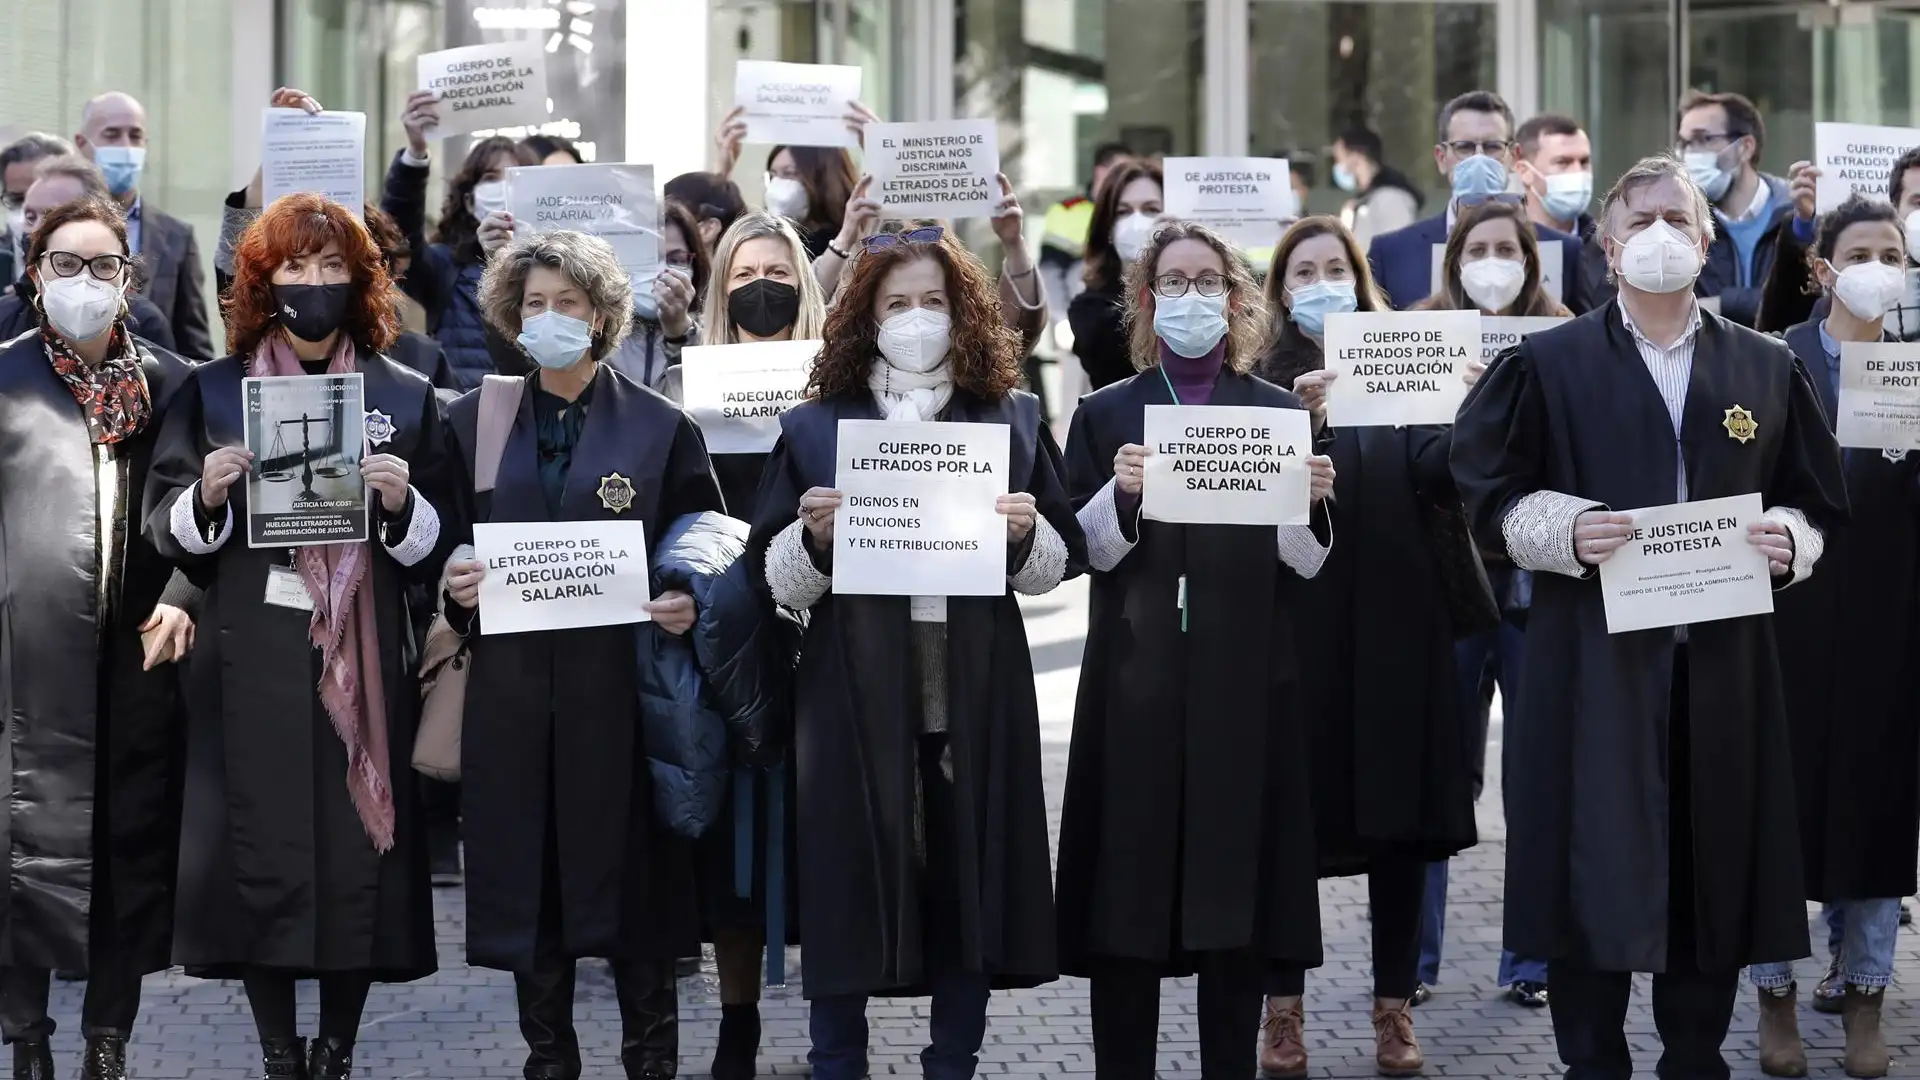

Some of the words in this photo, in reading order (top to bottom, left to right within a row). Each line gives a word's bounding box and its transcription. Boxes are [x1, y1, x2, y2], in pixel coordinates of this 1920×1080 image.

[447, 59, 494, 72] CUERPO
[497, 57, 512, 67] DE
[429, 73, 488, 88] LETRADOS
[492, 69, 516, 80] POR
[518, 67, 534, 76] LA
[442, 81, 524, 100] ADECUACIÓN
[452, 96, 515, 112] SALARIAL
[882, 139, 896, 148] EL
[902, 135, 966, 148] MINISTERIO
[970, 134, 983, 144] DE
[896, 149, 945, 160] JUSTICIA
[948, 148, 972, 157] NOS
[1846, 144, 1894, 155] CUERPO
[902, 161, 967, 172] DISCRIMINA
[1827, 156, 1888, 167] LETRADOS
[1185, 172, 1200, 181] DE
[1203, 172, 1253, 181] JUSTICIA
[1256, 172, 1270, 181] EN
[1839, 170, 1891, 180] ADECUA
[883, 178, 948, 191] LETRADOS
[952, 178, 968, 188] DE
[972, 177, 987, 187] LA
[1199, 184, 1258, 194] PROTESTA
[883, 190, 988, 204] ADMINISTRACIÓN
[536, 210, 595, 221] SALARIAL
[1363, 332, 1420, 344] CUERPO
[1425, 331, 1442, 342] DE
[1482, 333, 1516, 344] ERPO
[1339, 347, 1412, 360] LETRADOS
[1417, 347, 1444, 358] POR
[1450, 346, 1466, 357] LA
[1353, 360, 1452, 376] ADECUACIÓN
[1867, 361, 1885, 371] DE
[1366, 380, 1440, 393] SALARIAL
[723, 406, 786, 418] SALARIA
[1185, 427, 1246, 439] CUERPO
[1251, 428, 1270, 439] DE
[878, 442, 942, 455] CUERPO
[946, 444, 966, 456] DE
[1159, 443, 1237, 455] LETRADOS
[1242, 444, 1272, 456] POR
[1277, 445, 1296, 456] LA
[852, 459, 932, 472] LETRADOS
[937, 461, 968, 473] POR
[973, 462, 992, 473] LA
[1173, 458, 1281, 474] ADECUACIÓN
[1186, 478, 1267, 491] SALARIAL
[850, 496, 899, 507] DIGNOS
[903, 498, 919, 508] EN
[849, 516, 920, 528] FUNCIONES
[1648, 520, 1713, 538] JUSTICIA
[1718, 517, 1737, 529] EN
[263, 528, 317, 536] ADMINISTRACIÓN
[514, 540, 576, 551] CUERPO
[580, 539, 600, 548] DE
[849, 538, 855, 548] Y
[860, 538, 875, 548] EN
[880, 539, 978, 551] RETRIBUCIONES
[1643, 536, 1721, 556] PROTESTA
[490, 552, 569, 569] LETRADOS
[574, 551, 605, 561] POR
[609, 549, 628, 558] LA
[506, 562, 615, 585] ADECUACIÓN
[522, 583, 604, 602] SALARIAL
[1620, 588, 1644, 597] CUERPO
[1654, 584, 1685, 592] LETRADOS
[1704, 575, 1754, 585] ADMINISTRACIÓN
